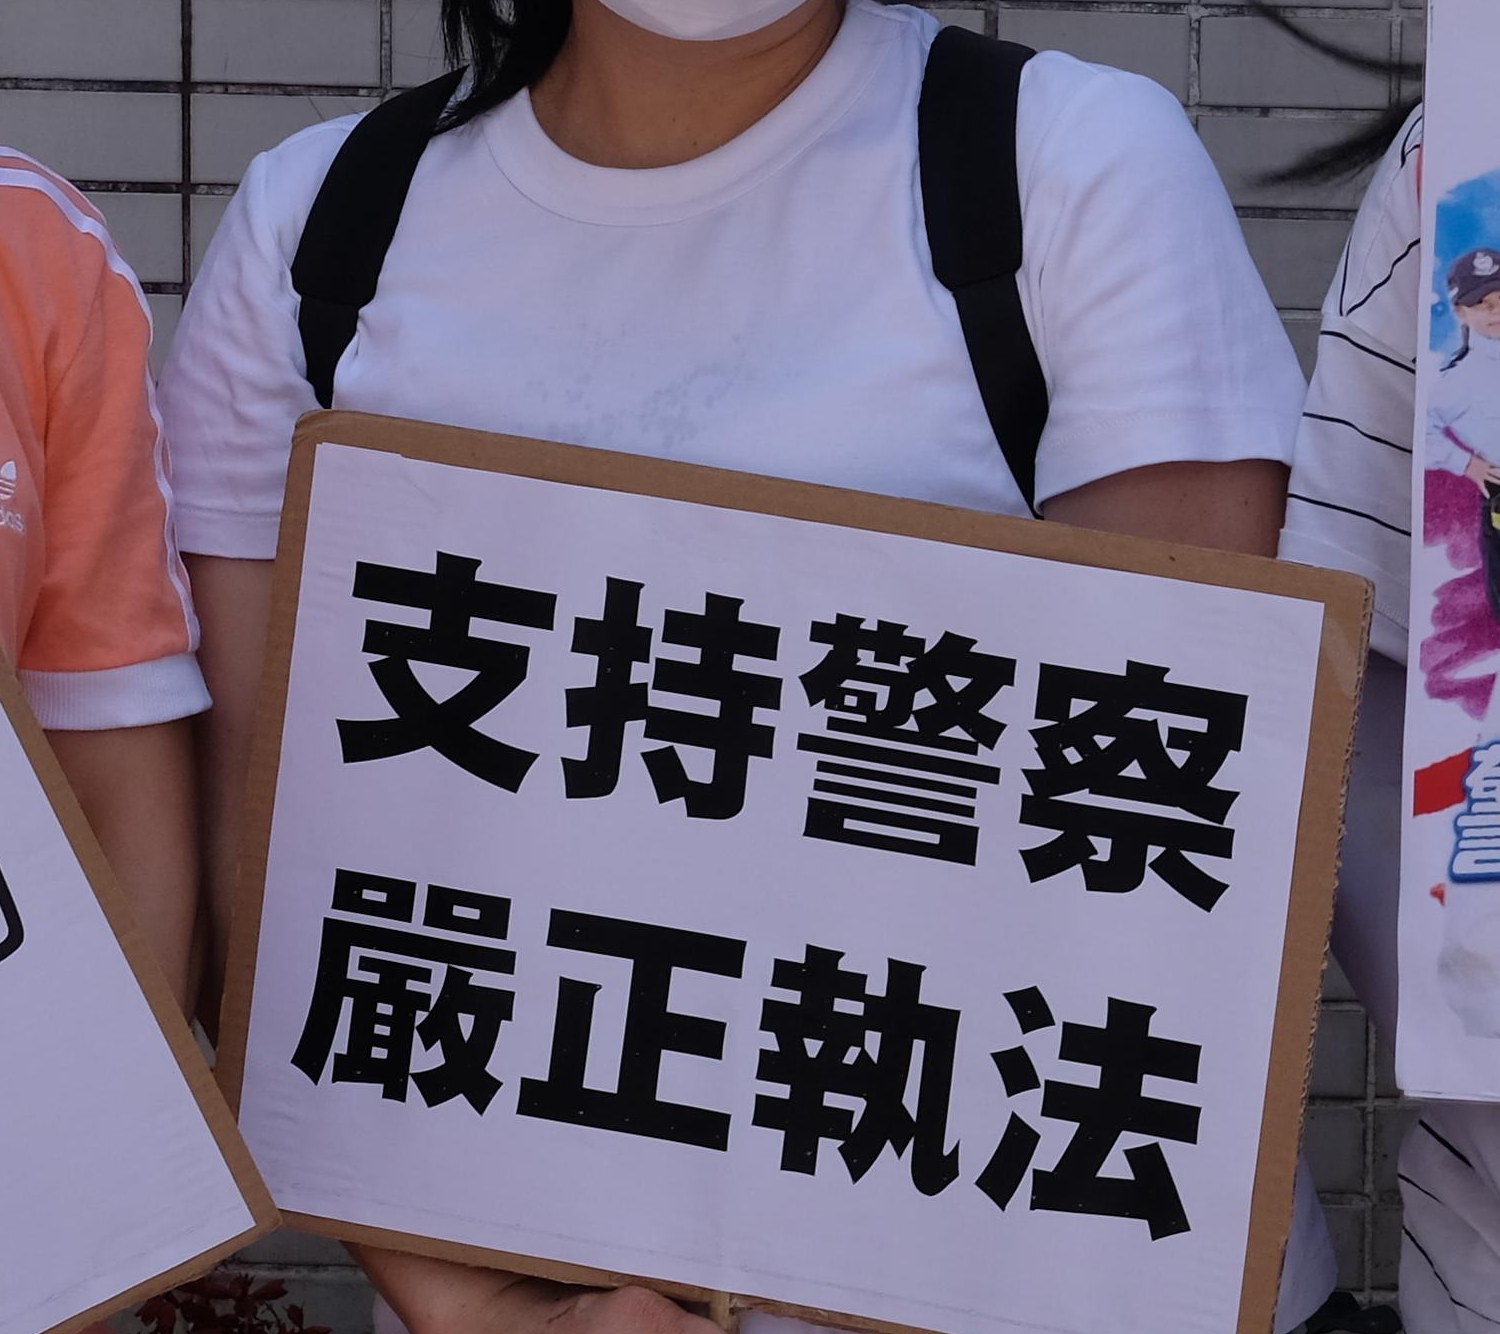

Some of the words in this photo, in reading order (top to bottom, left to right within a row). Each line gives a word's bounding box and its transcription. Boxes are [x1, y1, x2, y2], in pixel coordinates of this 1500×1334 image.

[336, 551, 1248, 912] 支持警察
[291, 869, 1201, 1241] 嚴正執法
